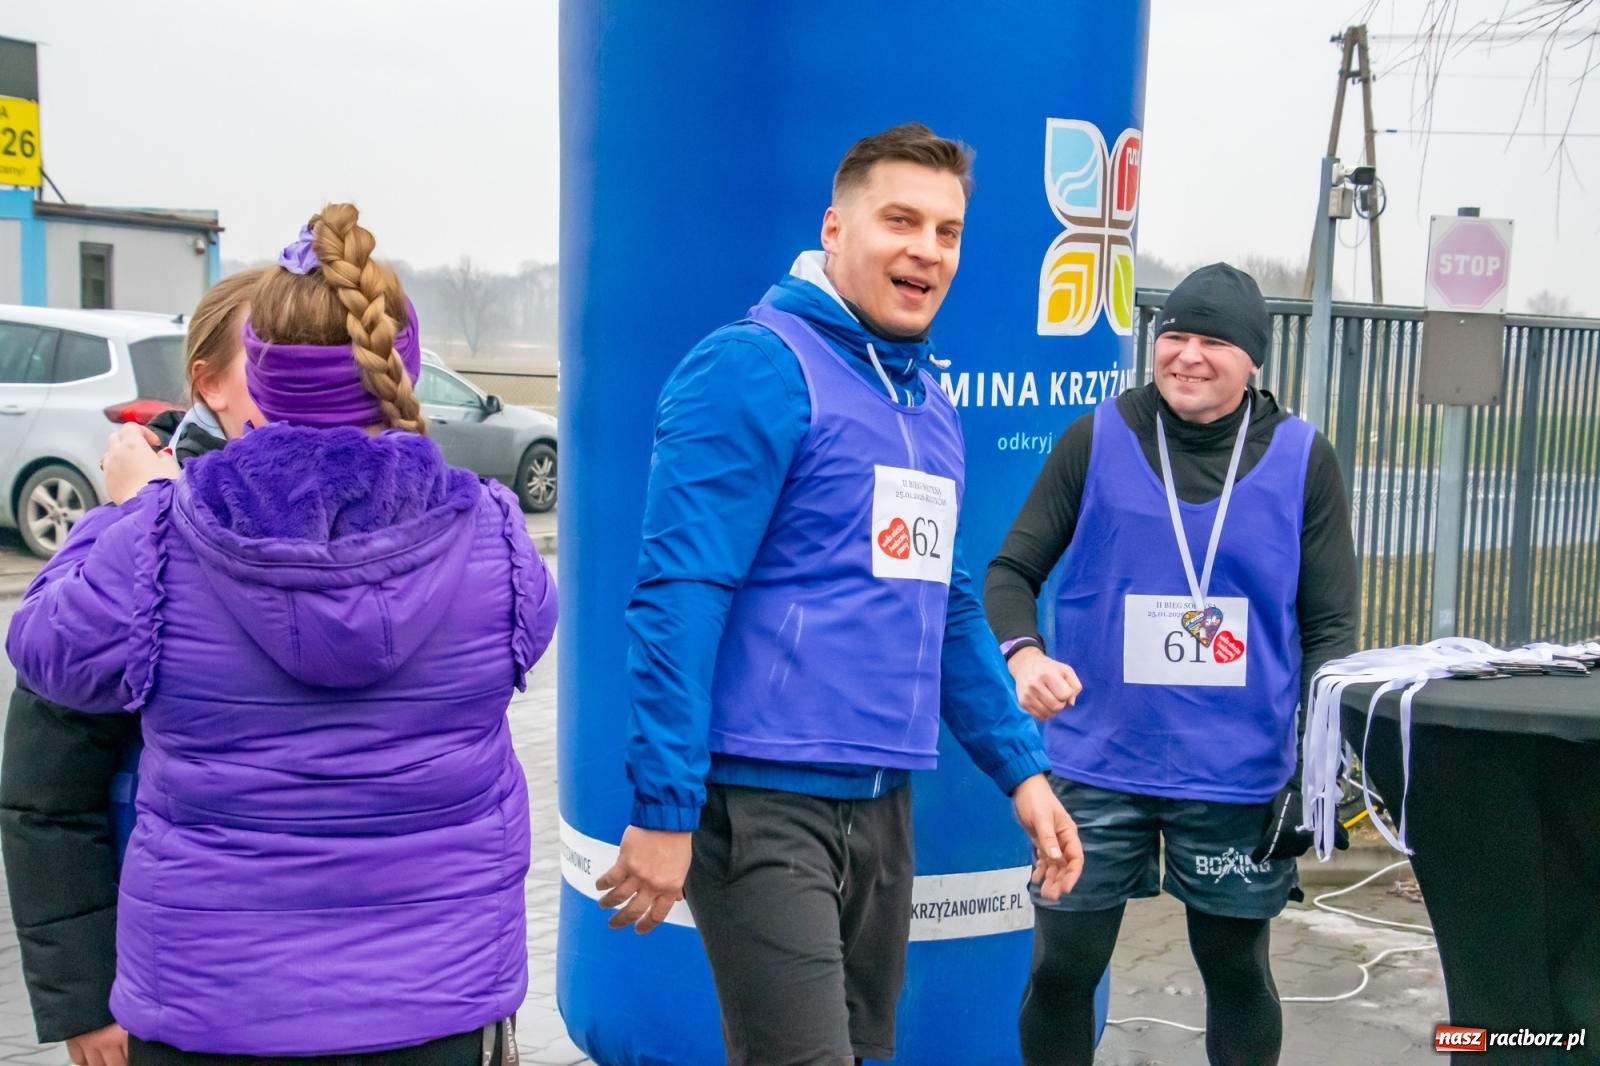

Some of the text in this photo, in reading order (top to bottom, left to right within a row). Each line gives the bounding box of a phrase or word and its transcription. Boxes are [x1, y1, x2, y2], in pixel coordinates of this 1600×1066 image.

[1, 127, 35, 158] 26
[1439, 254, 1501, 276] STOP
[998, 432, 1053, 454] odkryj
[912, 516, 940, 559] 62
[1164, 601, 1182, 609] BIEG
[1164, 630, 1206, 663] 61
[1195, 850, 1271, 876] BOXING
